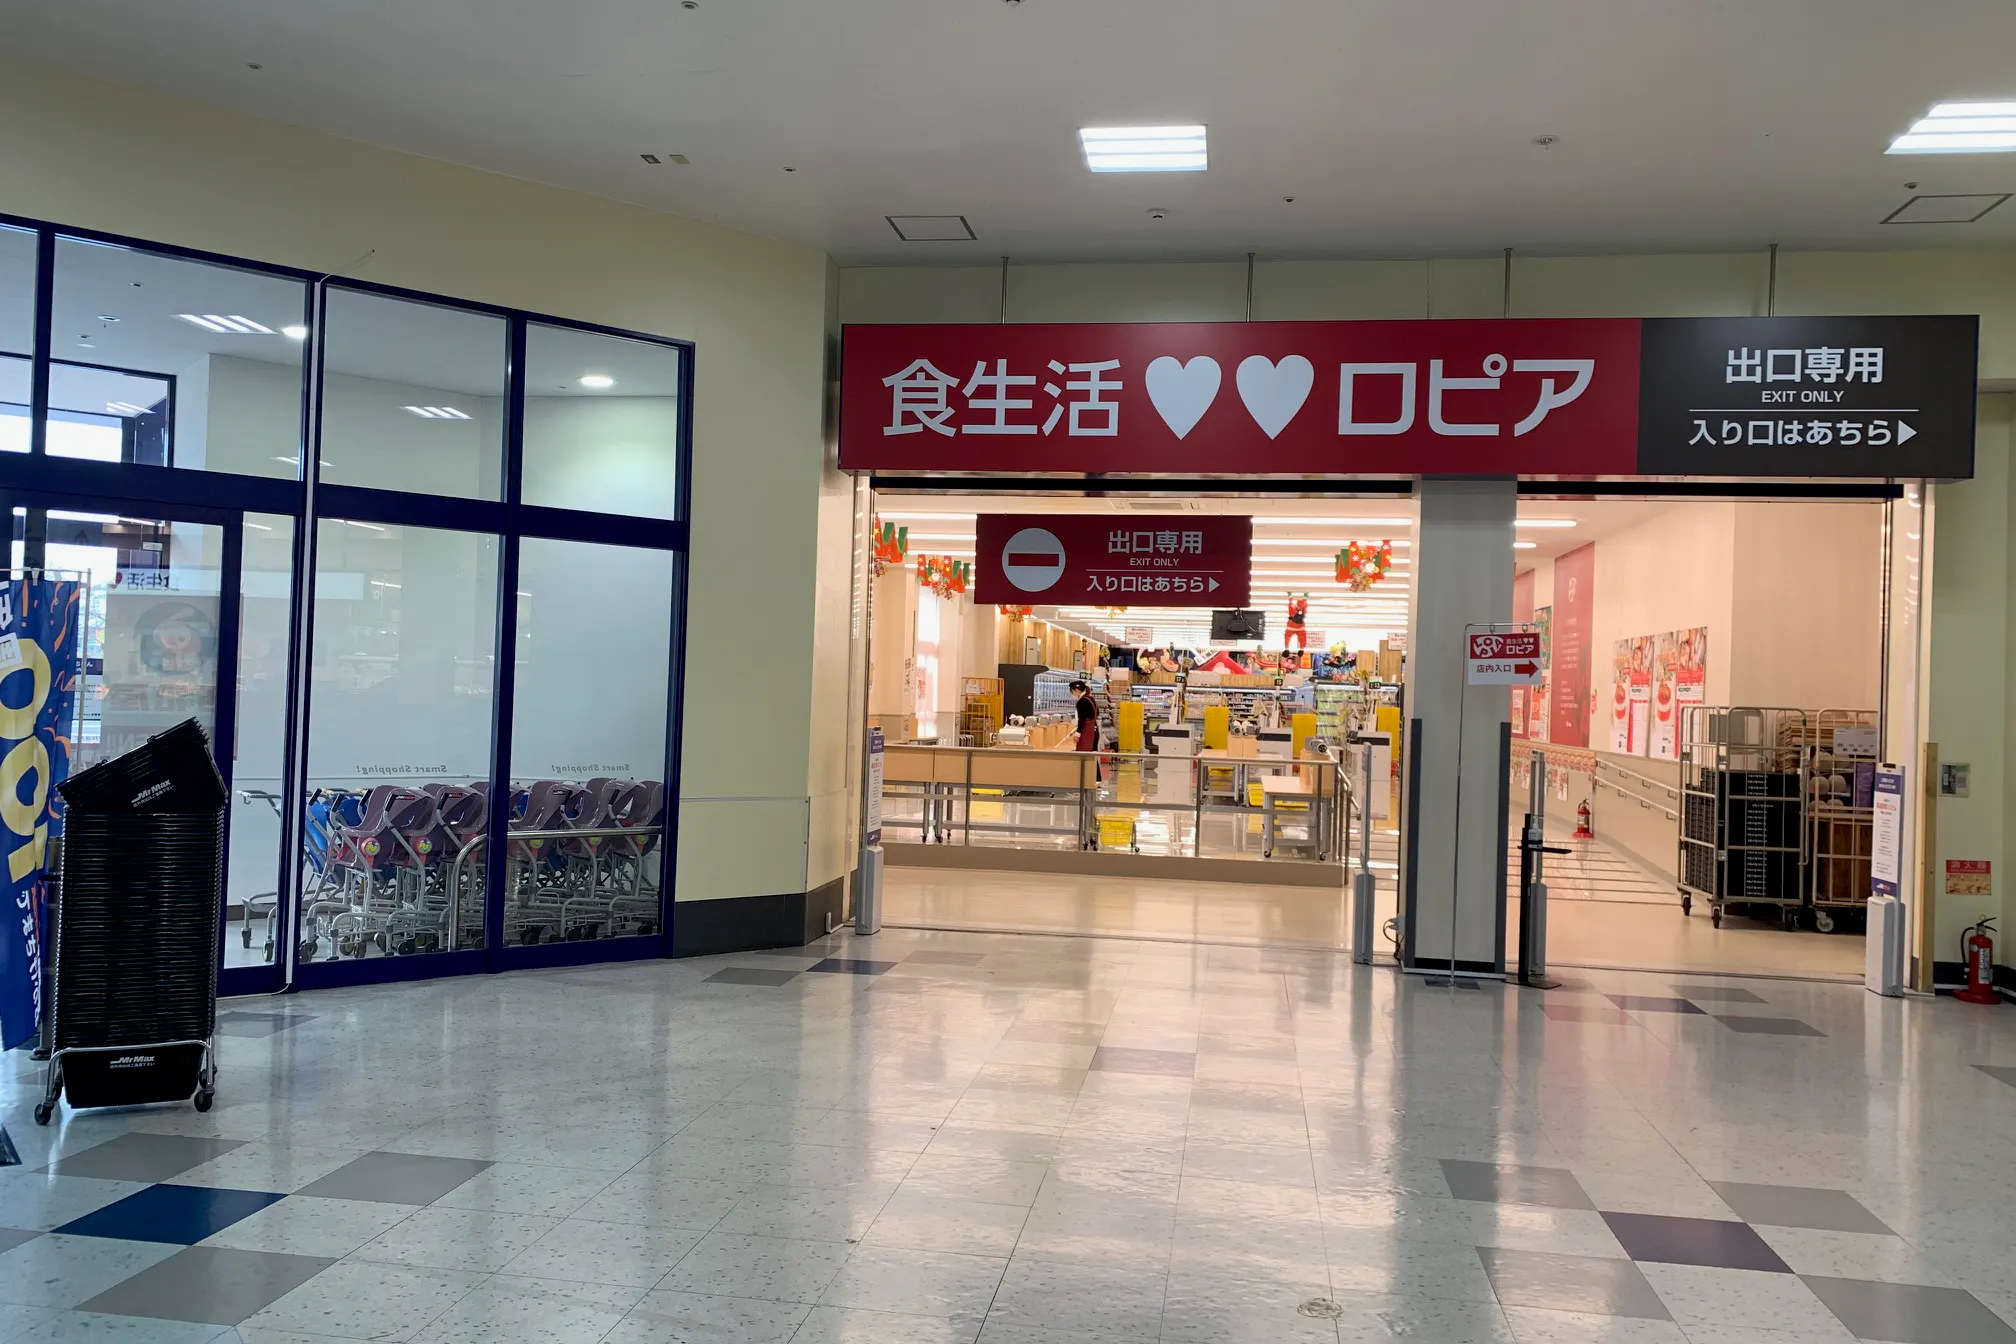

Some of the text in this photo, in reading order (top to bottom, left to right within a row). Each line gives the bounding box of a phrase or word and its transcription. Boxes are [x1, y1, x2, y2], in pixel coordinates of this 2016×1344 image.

[1725, 346, 1884, 384] 出口専用
[881, 352, 1596, 438] 食生活 ロピア
[1761, 390, 1845, 403] EXIT ONLY
[1688, 418, 1892, 447] 入り口はあちら
[1107, 530, 1203, 555] 出口専用
[1129, 557, 1179, 566] EXIT ONLY
[1086, 575, 1204, 593] 入り口はあちら
[1506, 645, 1535, 655] ロピア
[1476, 664, 1512, 673] 店内入口
[131, 779, 171, 804] MrMax
[110, 1055, 155, 1065] MrMax
